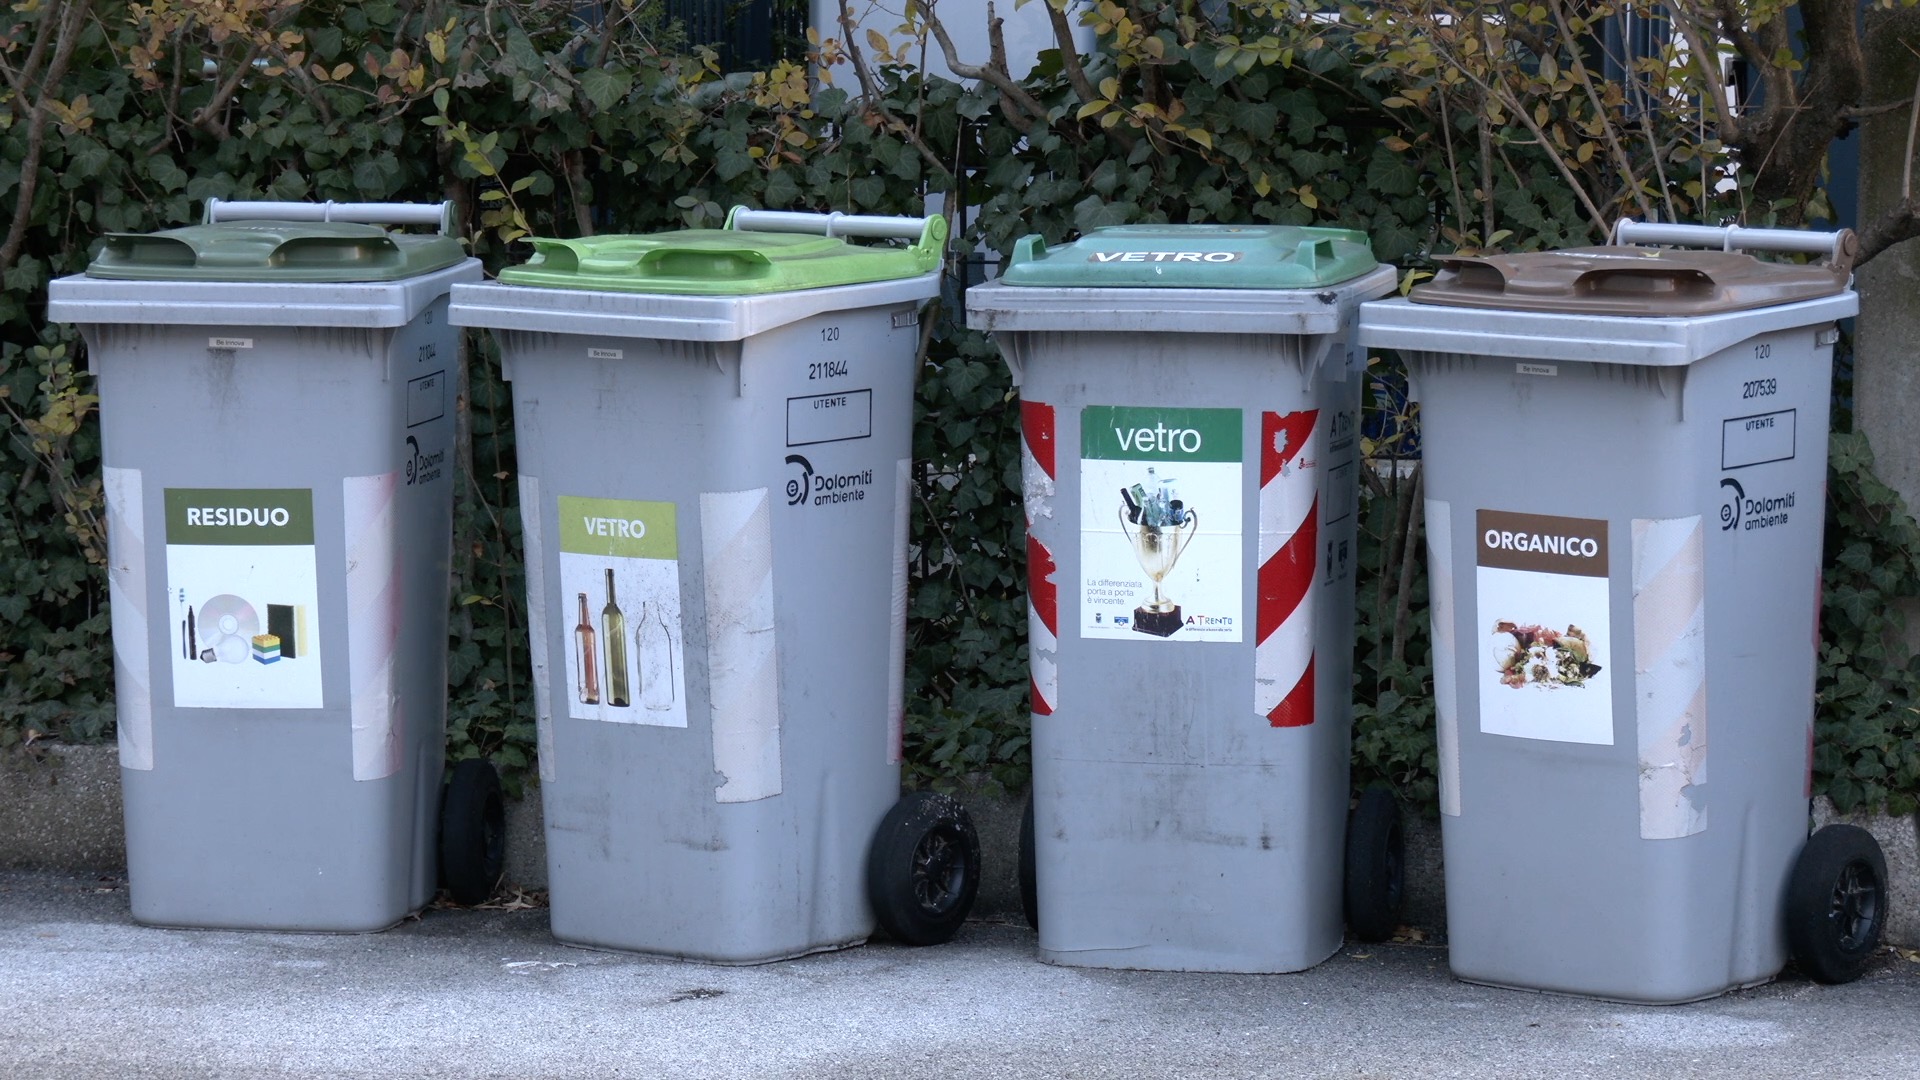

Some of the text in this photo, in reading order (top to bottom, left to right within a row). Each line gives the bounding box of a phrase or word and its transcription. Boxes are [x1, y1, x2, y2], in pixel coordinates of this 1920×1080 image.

[1095, 251, 1235, 262] VETRO
[821, 327, 840, 342] 120
[1755, 344, 1770, 359] 120
[809, 360, 848, 380] 211844
[1743, 378, 1777, 399] 207539
[814, 397, 847, 409] UTENTE
[1745, 417, 1775, 431] UTENTE
[1115, 422, 1201, 453] vetro
[419, 448, 444, 471] Dolomiti
[419, 467, 441, 484] ambiente
[815, 469, 873, 491] Dolomiti
[814, 488, 865, 506] ambiente
[1745, 491, 1795, 515] Dolomiti
[187, 507, 290, 526] RESIDUO
[1745, 512, 1788, 530] ambiente
[584, 516, 646, 539] VETRO
[1484, 529, 1598, 558] ORGANICO
[1087, 588, 1106, 596] porta
[1114, 589, 1134, 597] porta
[1098, 579, 1143, 588] differenziata
[1094, 597, 1125, 605] vincente
[1185, 616, 1195, 625] A
